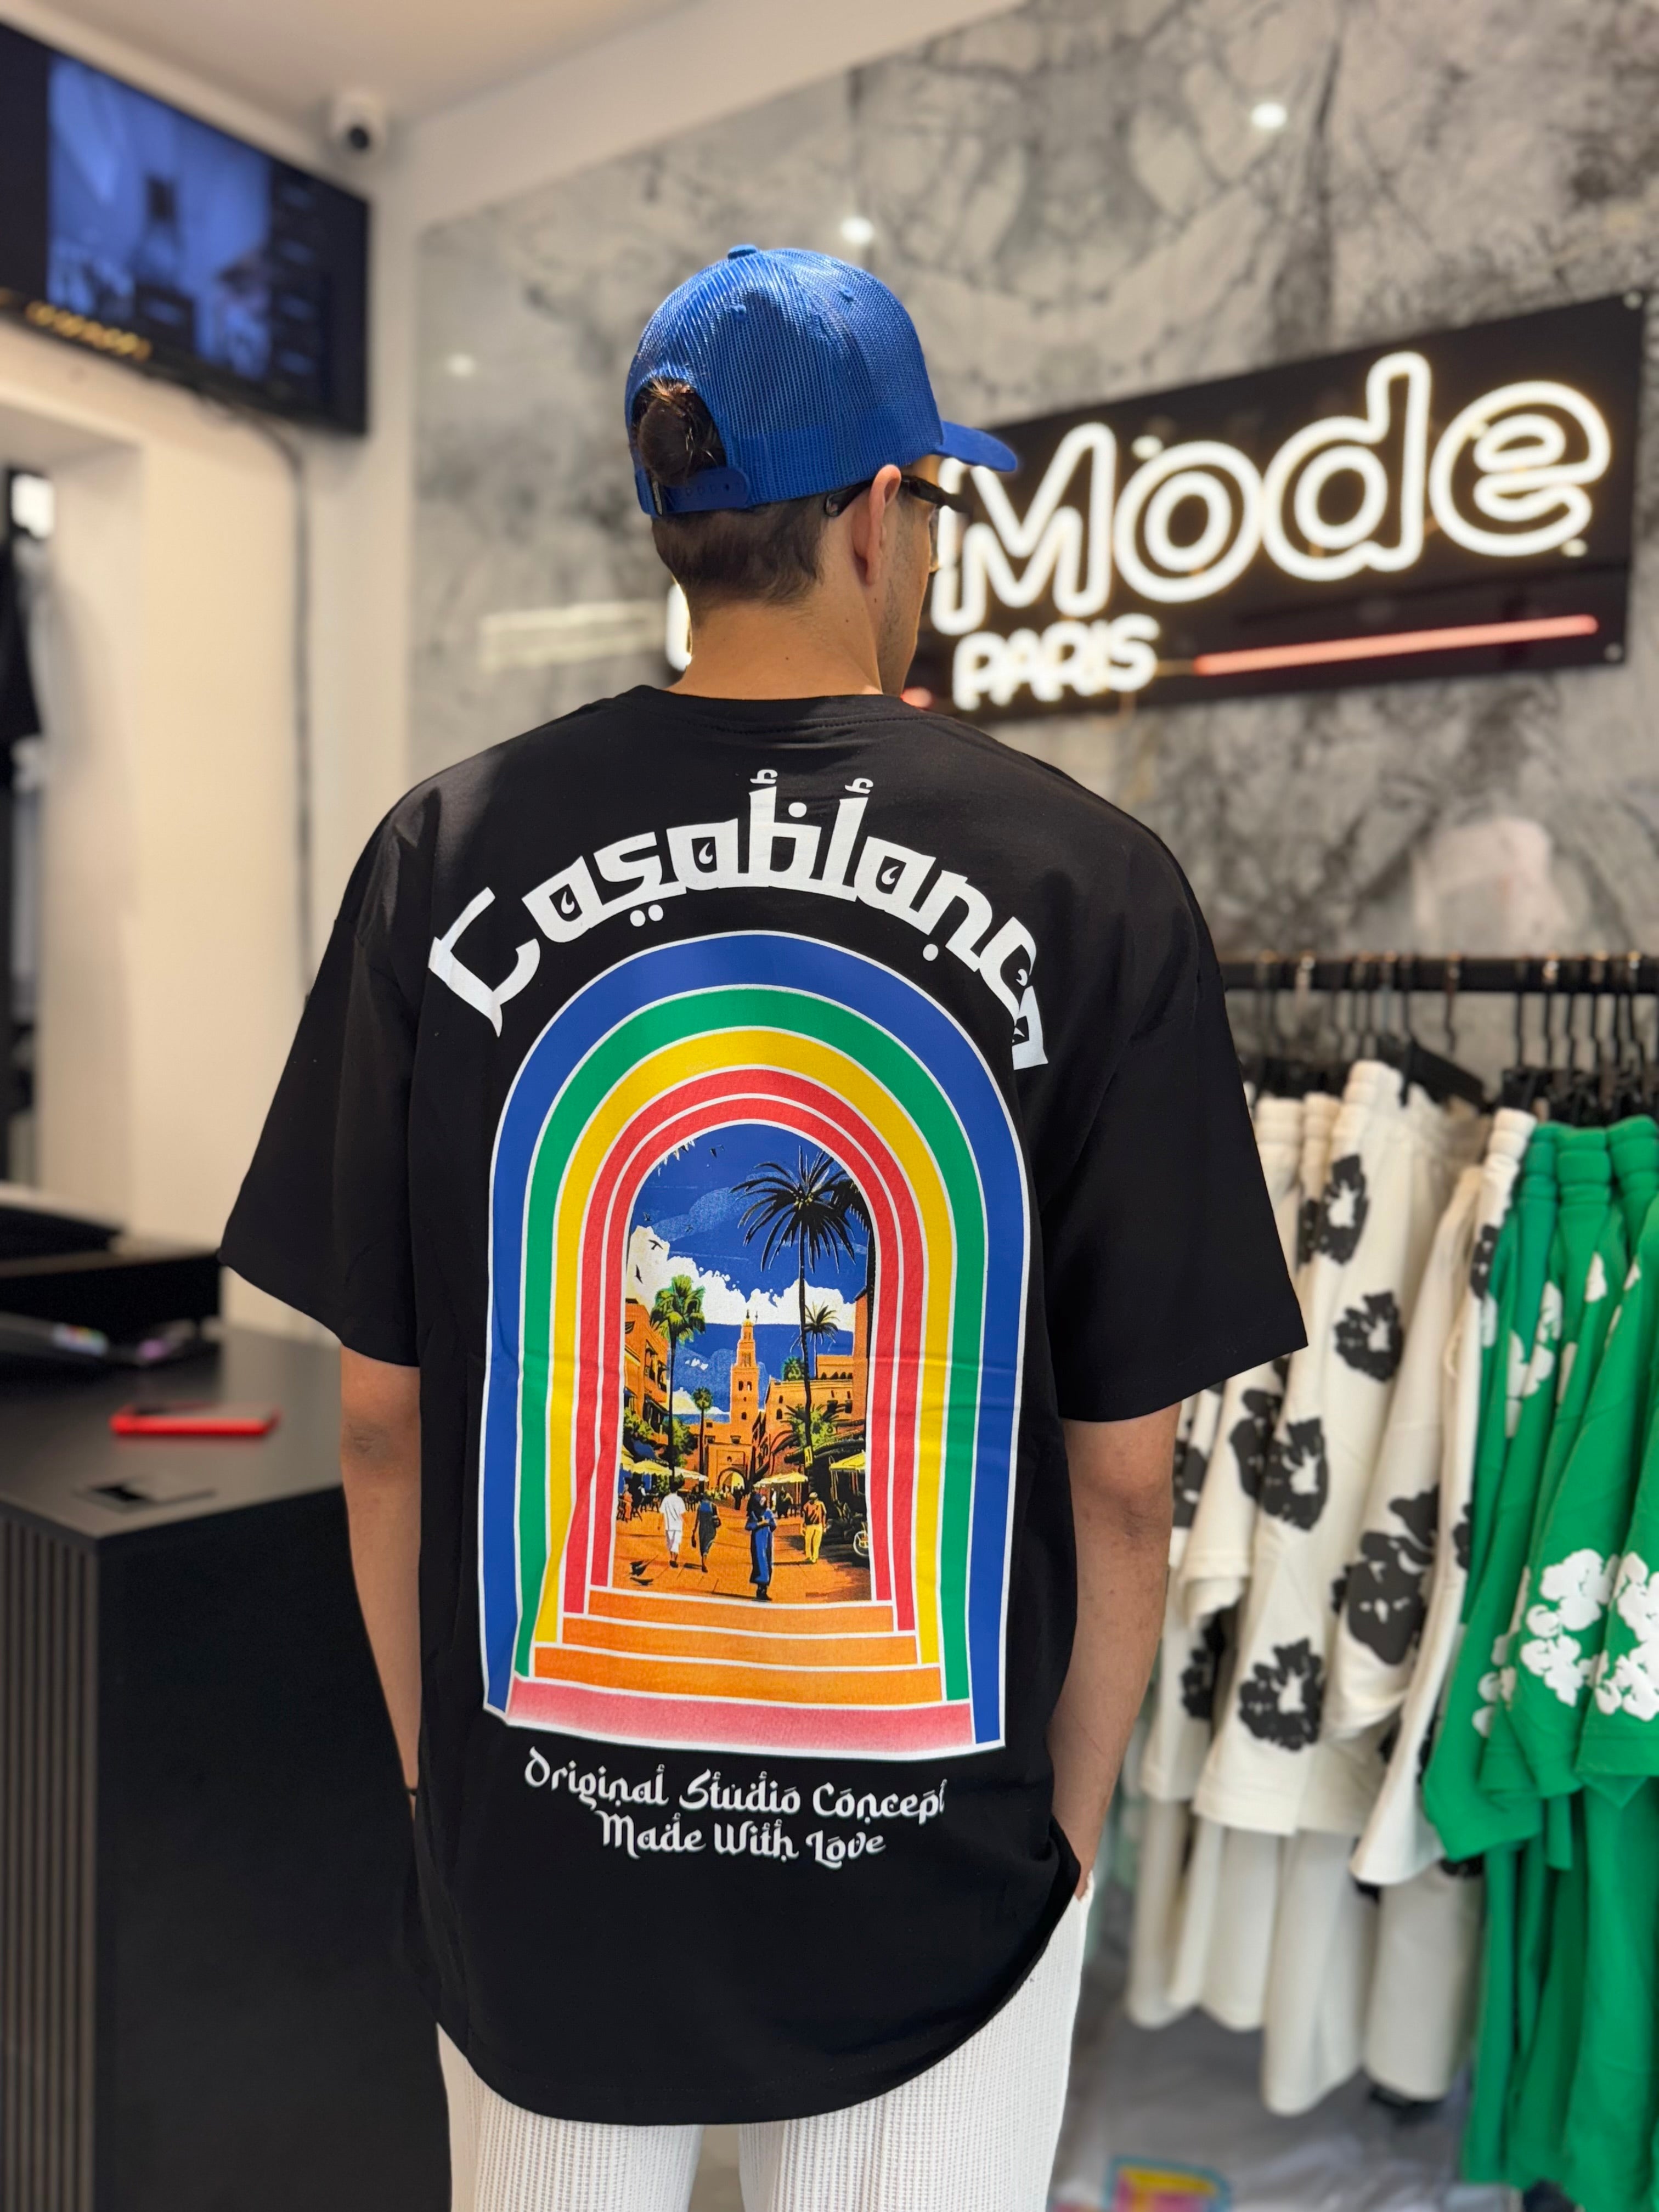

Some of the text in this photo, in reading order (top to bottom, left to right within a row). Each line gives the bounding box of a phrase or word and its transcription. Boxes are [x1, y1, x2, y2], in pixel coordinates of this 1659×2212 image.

[930, 351, 1612, 636] Mode
[952, 613, 1160, 712] PARIS
[524, 1746, 669, 1812] Original
[678, 1768, 802, 1814] Studio
[594, 1810, 887, 1870] Made With Love
